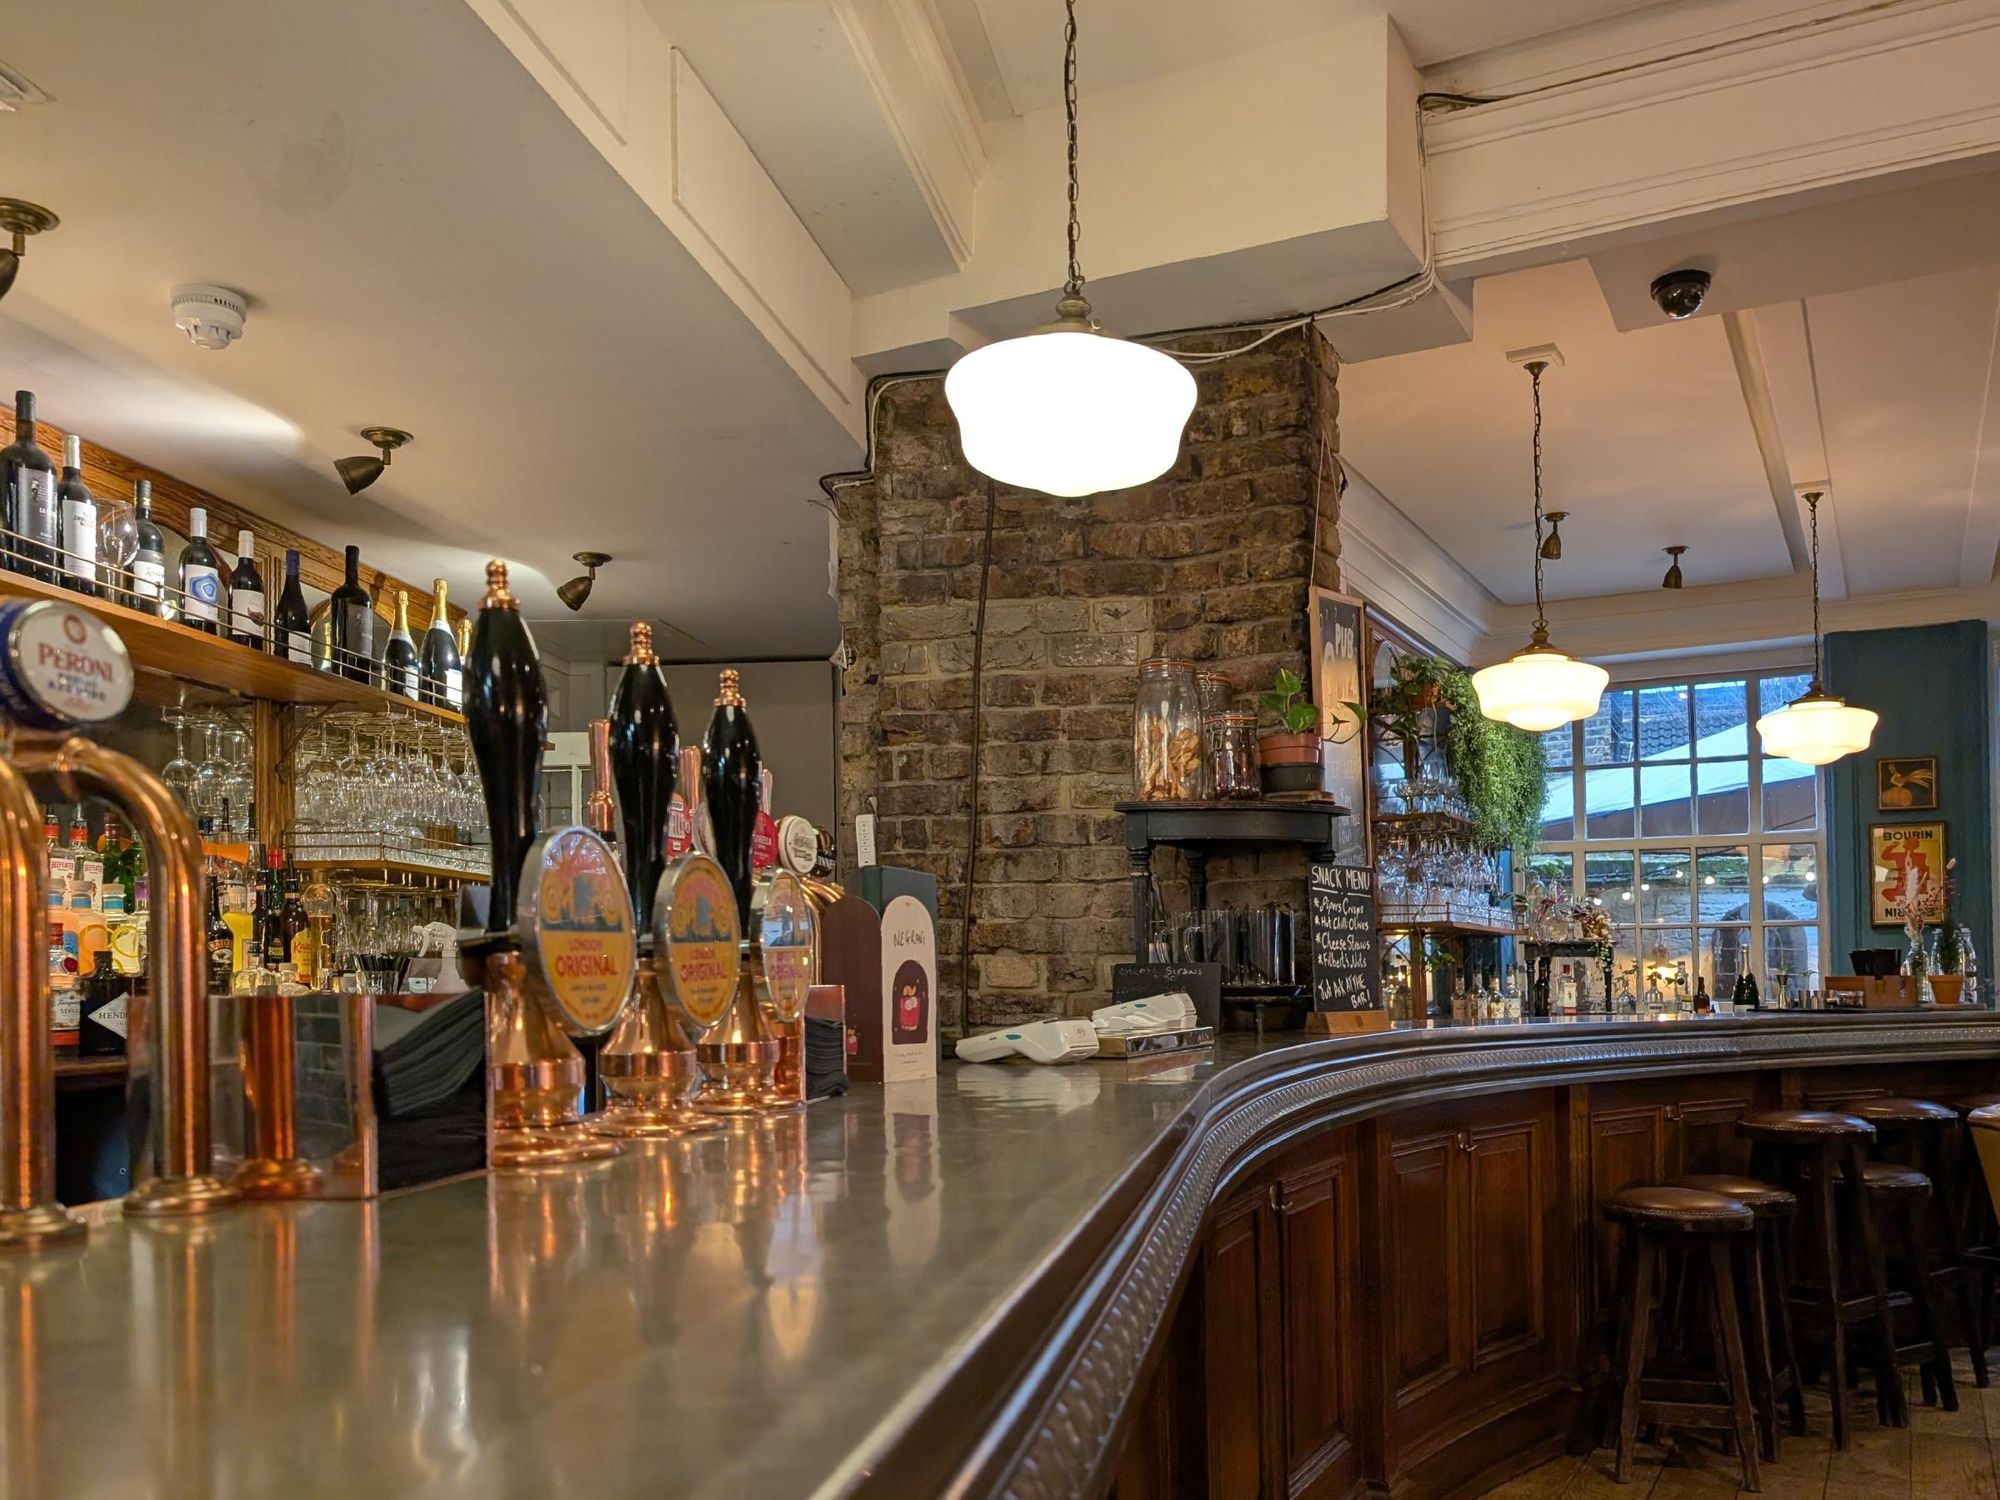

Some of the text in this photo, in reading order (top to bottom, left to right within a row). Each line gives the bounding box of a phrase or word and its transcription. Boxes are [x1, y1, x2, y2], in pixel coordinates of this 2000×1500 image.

[1335, 623, 1354, 660] PUB
[38, 642, 113, 684] PERONI
[1883, 831, 1933, 841] BOURIN
[1311, 865, 1371, 891] SNACK MENU
[1342, 897, 1364, 919] Crisps
[1321, 931, 1347, 951] Cheese
[555, 955, 618, 977] ORIGINAL
[680, 963, 728, 981] ORIGINAL
[1350, 988, 1373, 1009] BAR!
